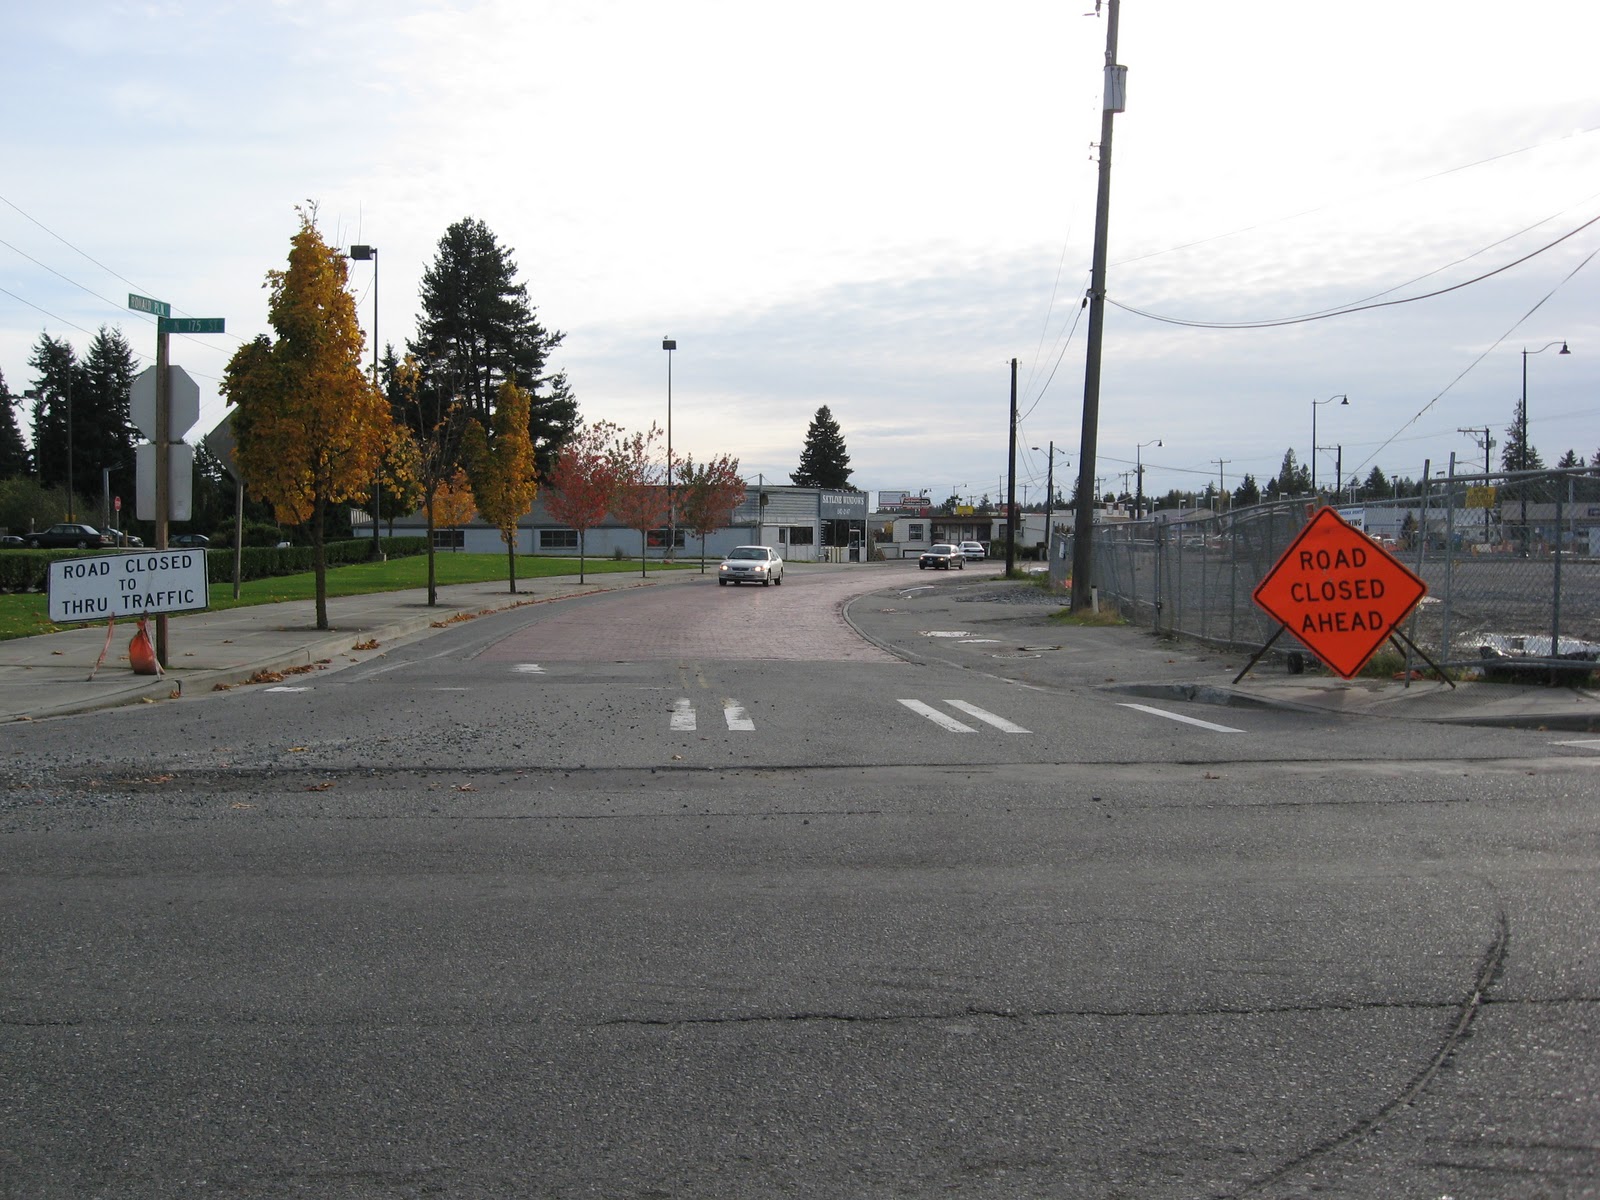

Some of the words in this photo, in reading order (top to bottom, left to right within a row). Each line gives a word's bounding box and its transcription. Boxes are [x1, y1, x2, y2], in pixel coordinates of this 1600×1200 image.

[131, 296, 151, 312] RONALD
[188, 320, 201, 332] 175
[208, 320, 218, 331] ST
[843, 496, 865, 505] WINDOWS
[64, 561, 110, 579] ROAD
[125, 555, 192, 573] CLOSED
[1300, 548, 1366, 570] ROAD
[119, 578, 137, 591] TO
[1291, 579, 1384, 602] CLOSED
[62, 597, 108, 615] THRU
[122, 589, 194, 609] TRAFFIC
[1302, 611, 1383, 632] AHEAD
